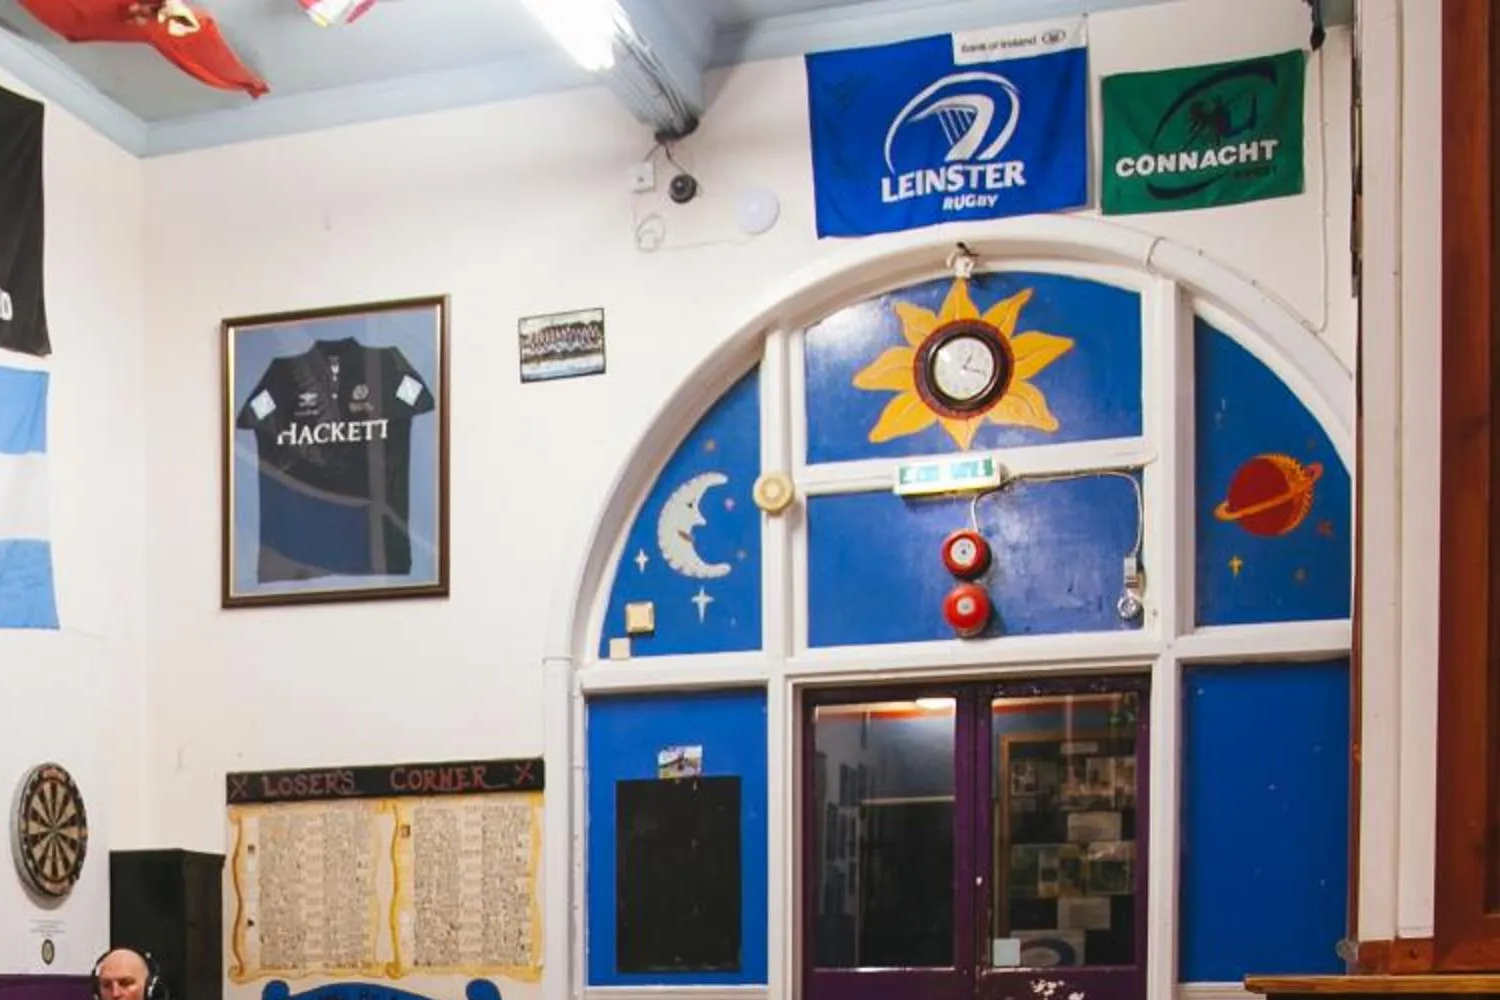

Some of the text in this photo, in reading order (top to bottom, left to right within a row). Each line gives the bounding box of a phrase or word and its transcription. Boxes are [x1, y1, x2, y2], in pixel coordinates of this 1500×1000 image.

[1115, 139, 1279, 177] CONNACHT
[881, 161, 1026, 203] LEINSTER
[942, 194, 999, 211] RUGBY
[276, 419, 389, 445] HACKETT
[390, 765, 493, 792] CORNER
